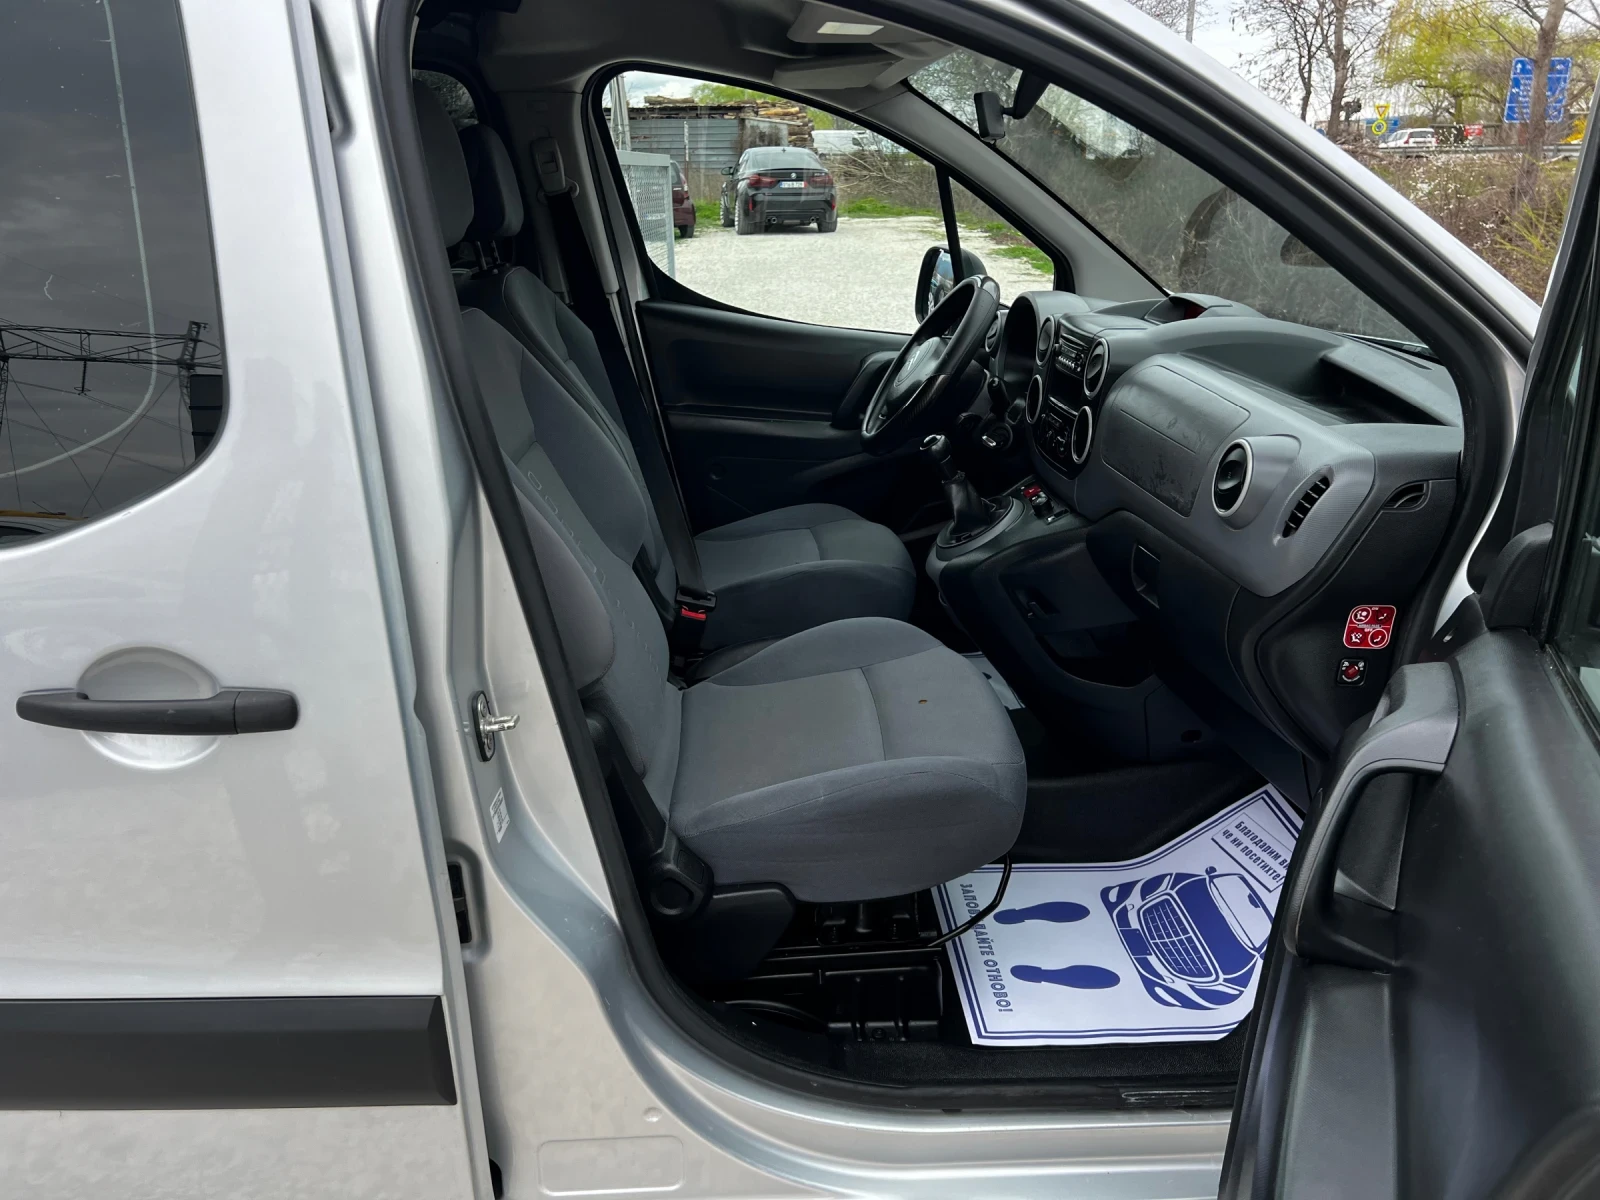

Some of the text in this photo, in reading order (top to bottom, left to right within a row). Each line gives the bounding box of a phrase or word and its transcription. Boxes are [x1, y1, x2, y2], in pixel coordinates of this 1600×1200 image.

[1222, 829, 1286, 883] че ни посетихте!
[1235, 820, 1282, 861] Благодарим
[960, 883, 1013, 1012] ЗАПОВДАЙТЕ ОТНОВО!
